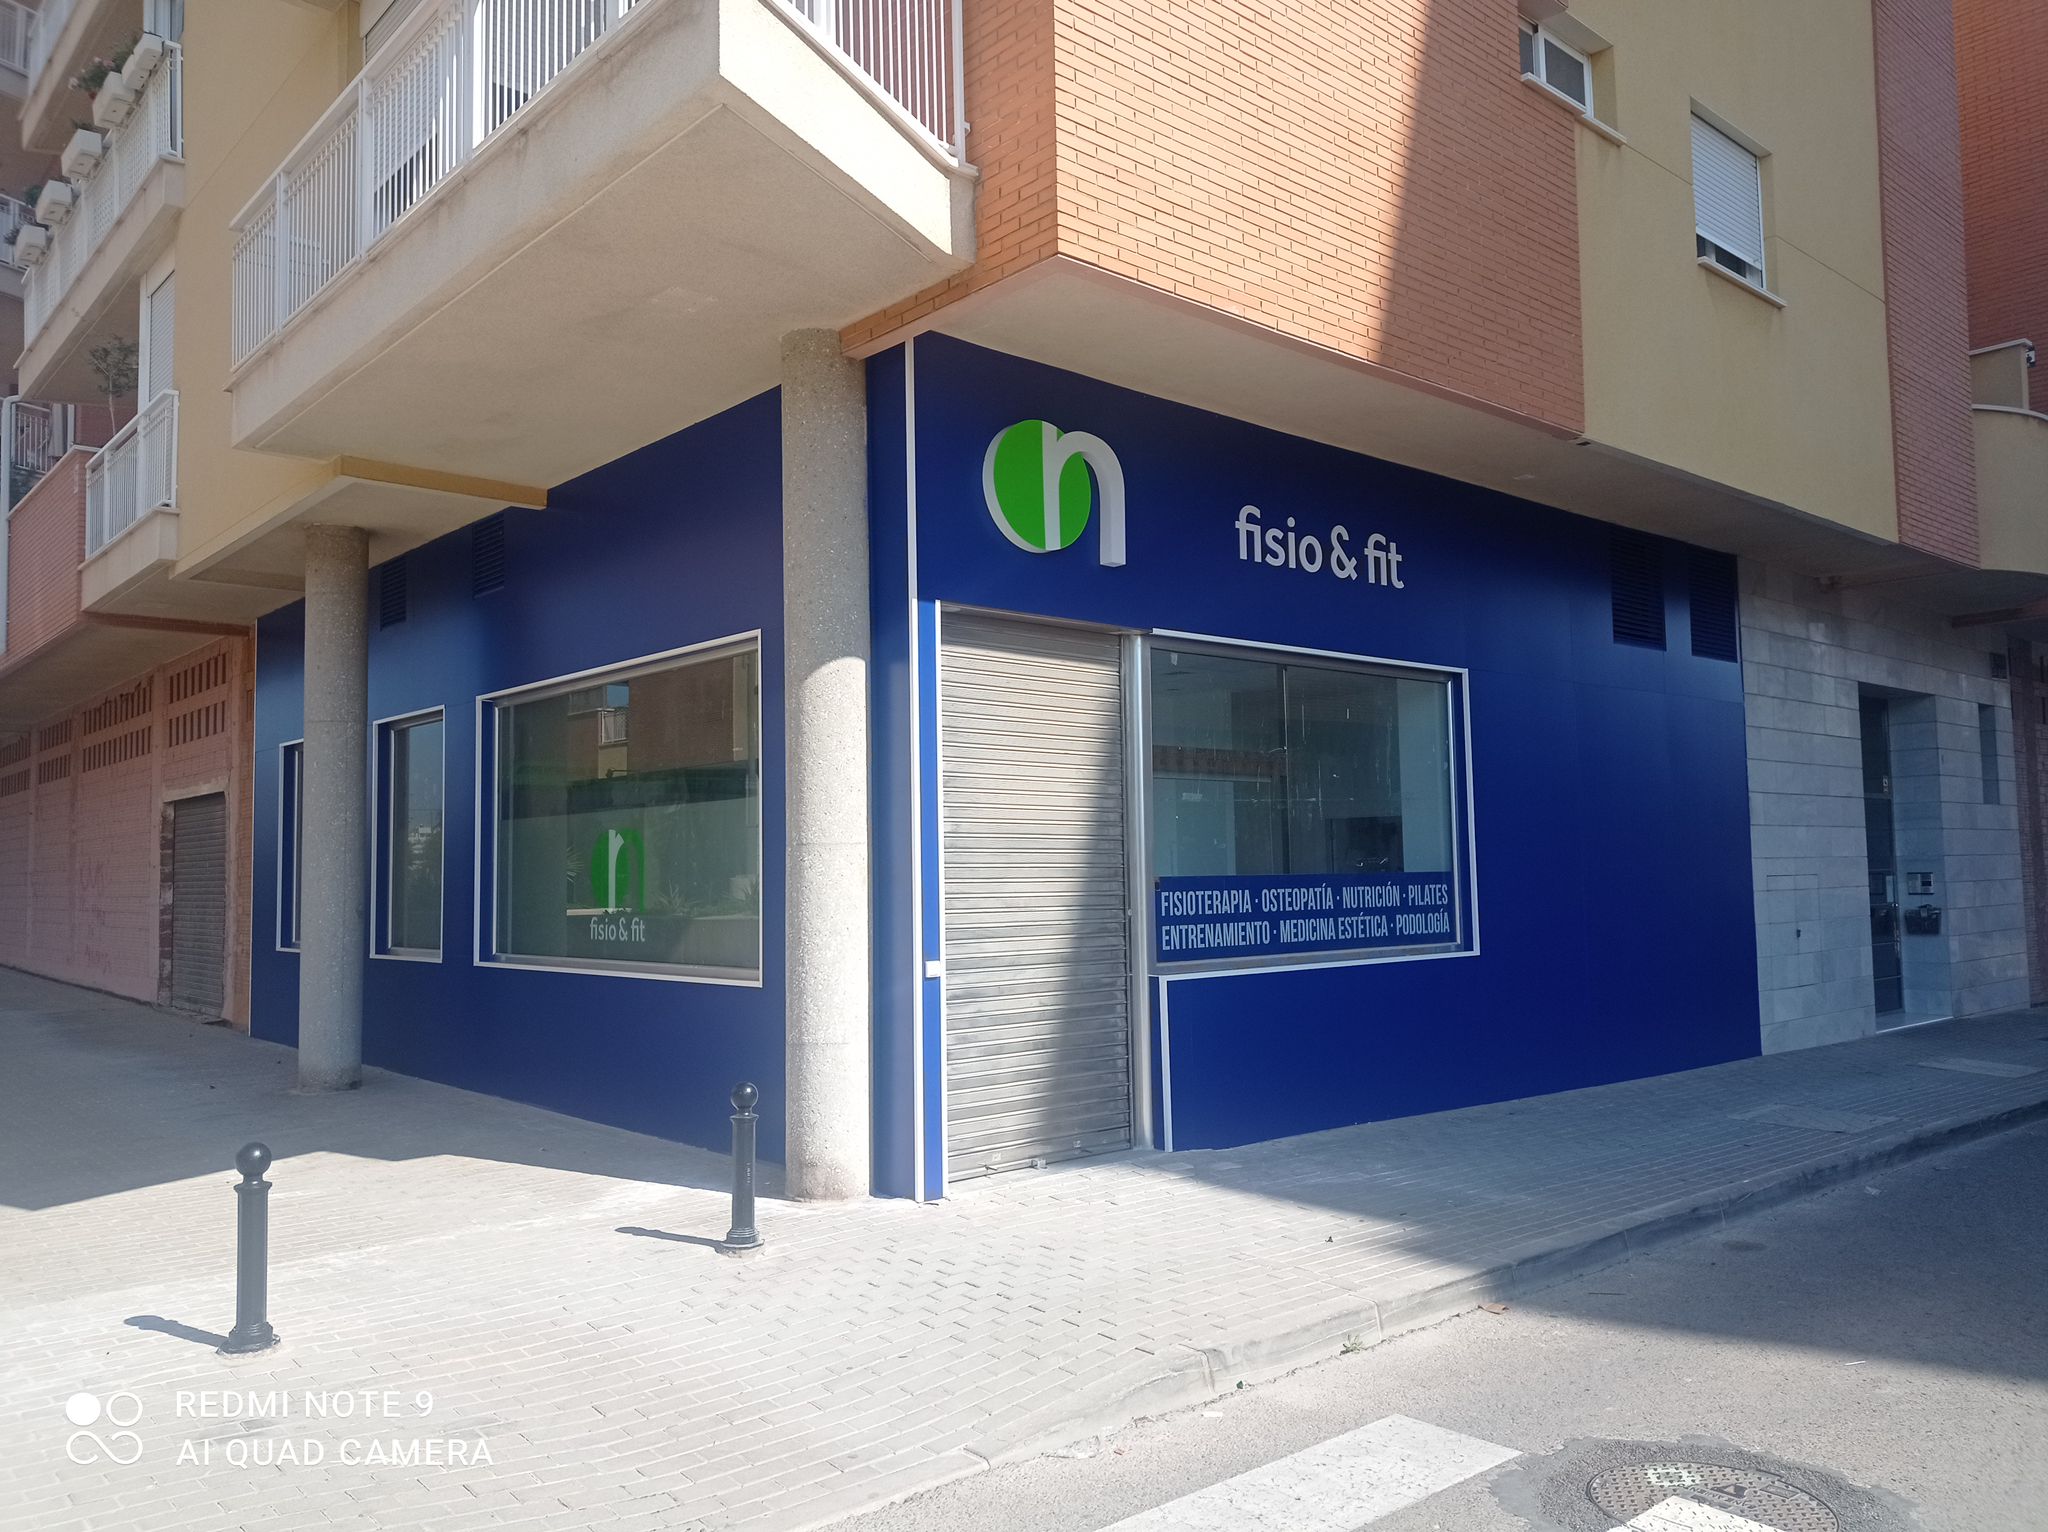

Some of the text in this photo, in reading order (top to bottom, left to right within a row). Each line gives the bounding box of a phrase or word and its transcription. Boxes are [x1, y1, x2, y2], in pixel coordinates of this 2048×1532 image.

[1235, 505, 1405, 589] fisio & fit
[1161, 881, 1448, 917] FISIOTERAPIA OSTEOPATÍA NUTRICIÓN PILATES
[590, 916, 645, 942] fisio & fit
[1162, 908, 1450, 951] ENTRENAMIENTO MEDICINA ESTÉTICA PODOLOGÍA
